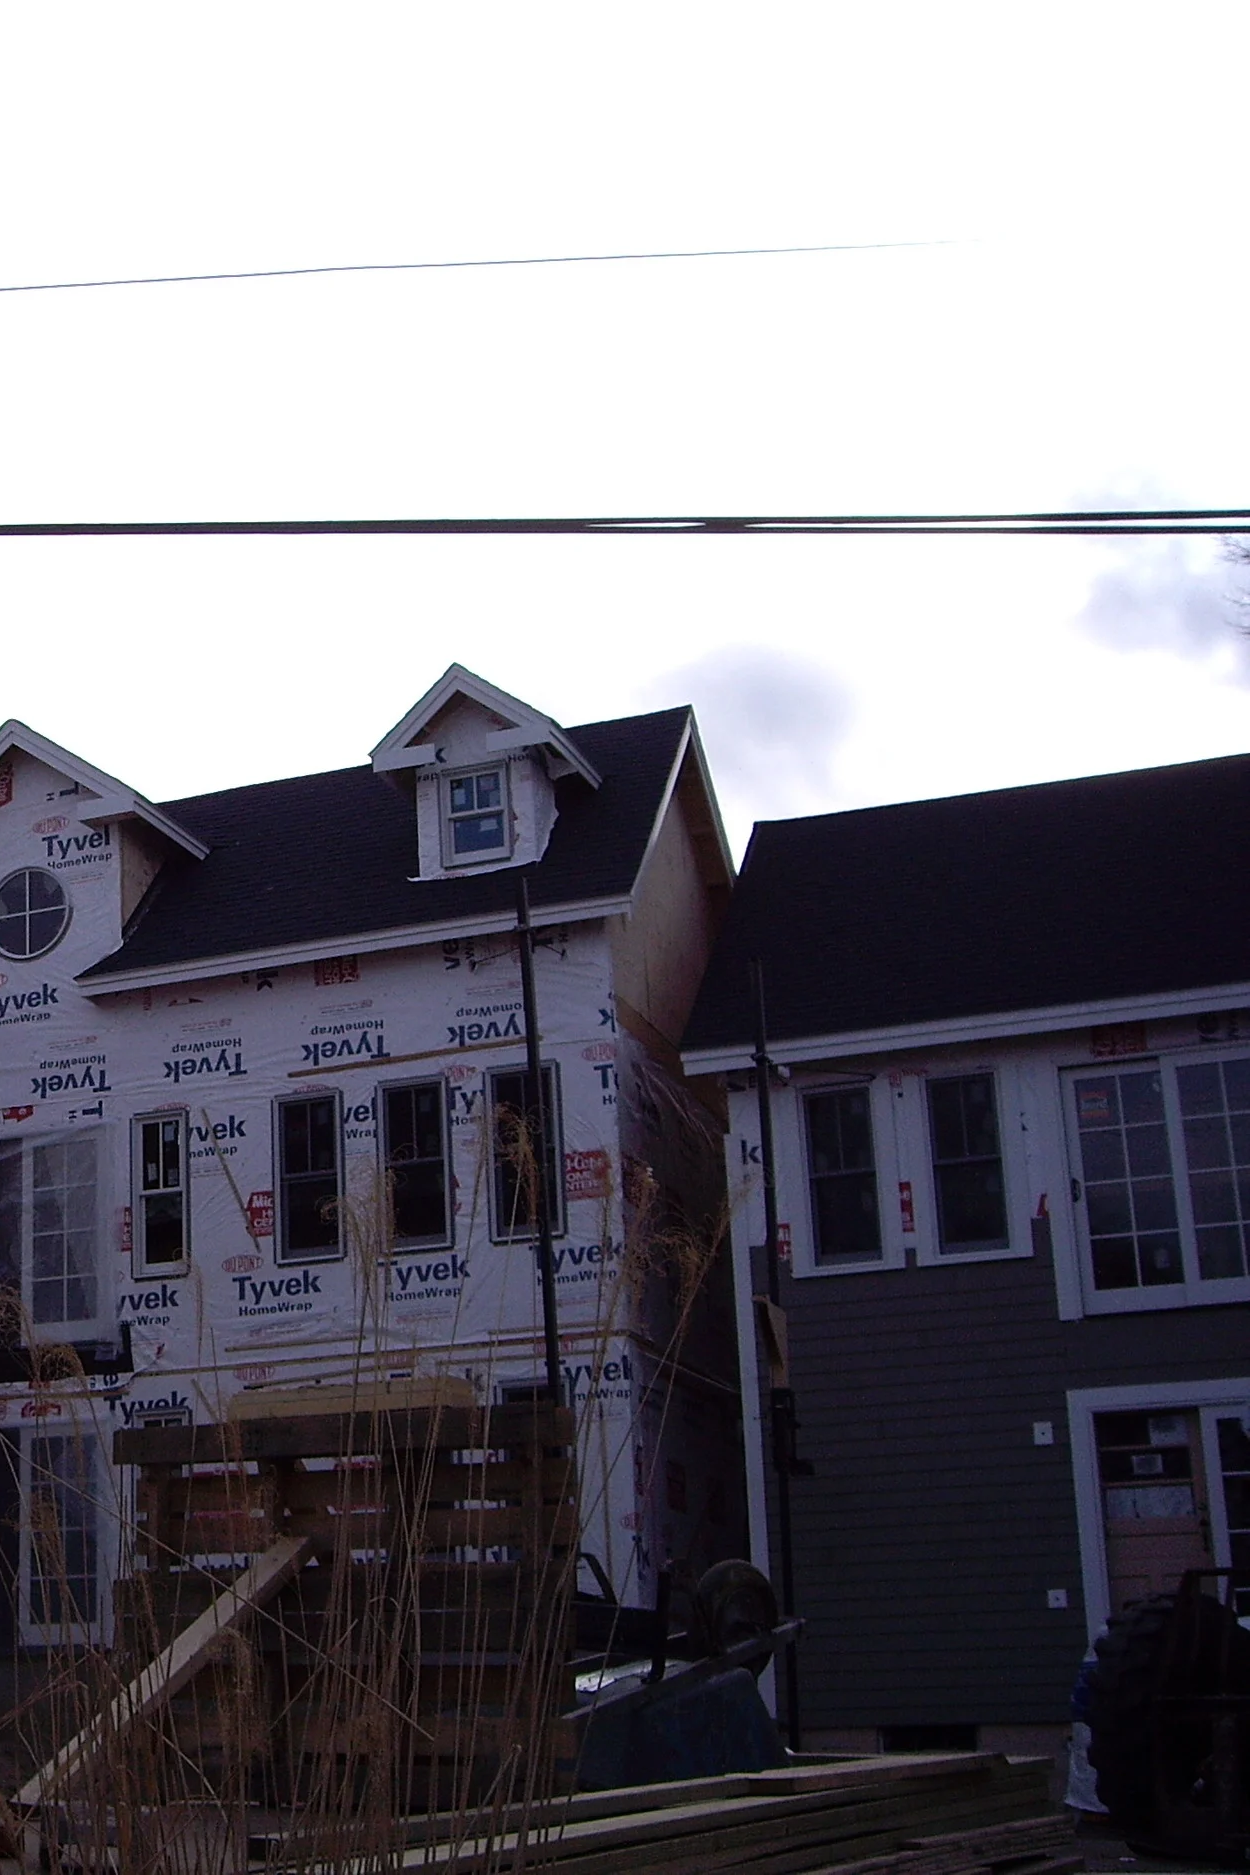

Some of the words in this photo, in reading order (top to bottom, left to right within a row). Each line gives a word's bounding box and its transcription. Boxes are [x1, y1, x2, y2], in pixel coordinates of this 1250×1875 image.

[48, 852, 113, 870] HomeWrap
[455, 1003, 524, 1018] omeWrap
[311, 1020, 384, 1036] HomeWrap
[446, 1013, 524, 1048] yvek
[171, 1037, 242, 1053] HomeWrap
[302, 1035, 391, 1066] Tyvek
[39, 1054, 106, 1070] HomeWrap
[163, 1052, 247, 1083] Tyvek
[31, 1069, 111, 1099] Tyvek
[232, 1270, 322, 1305] Tyvek
[239, 1300, 313, 1317] HomeWrap
